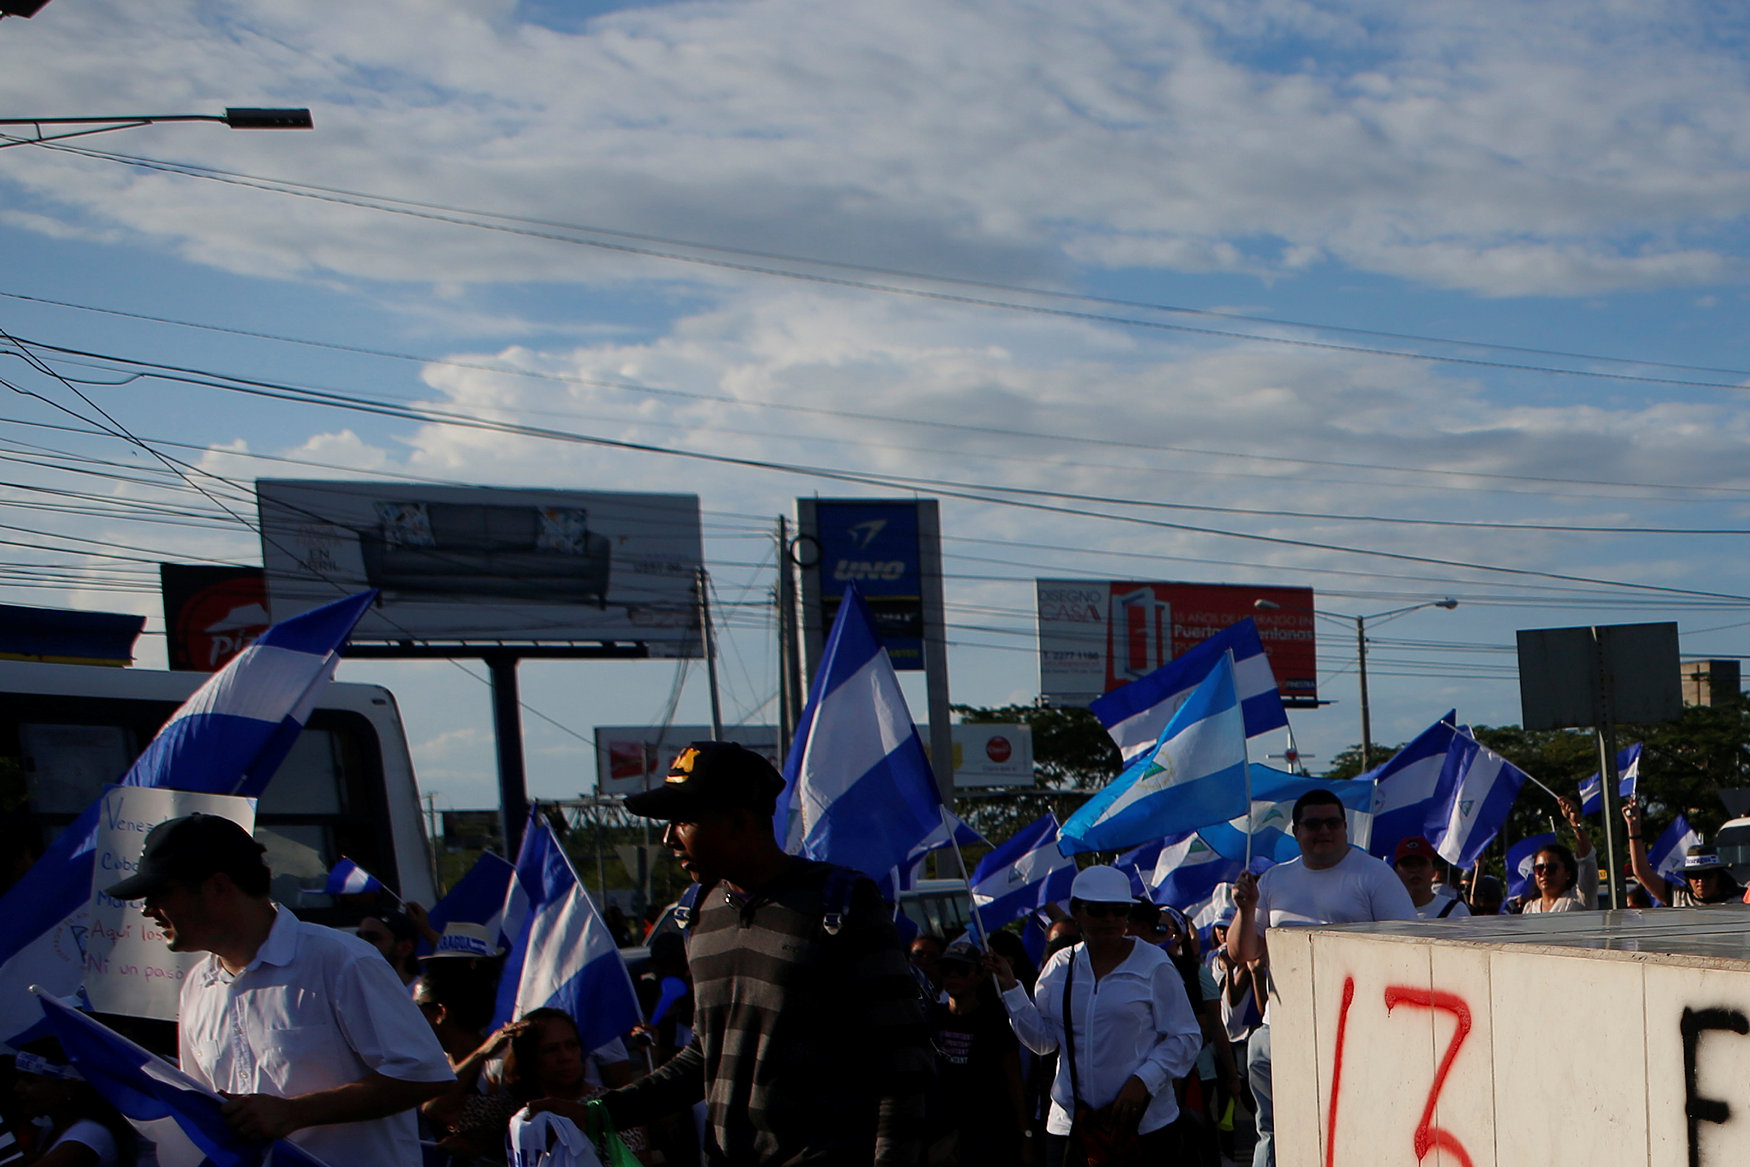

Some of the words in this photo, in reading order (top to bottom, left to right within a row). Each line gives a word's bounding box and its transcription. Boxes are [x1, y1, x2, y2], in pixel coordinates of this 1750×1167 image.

[834, 559, 906, 581] UNO
[1040, 603, 1102, 623] CASA
[142, 925, 163, 942] los
[87, 951, 111, 974] Ni
[120, 964, 138, 976] un
